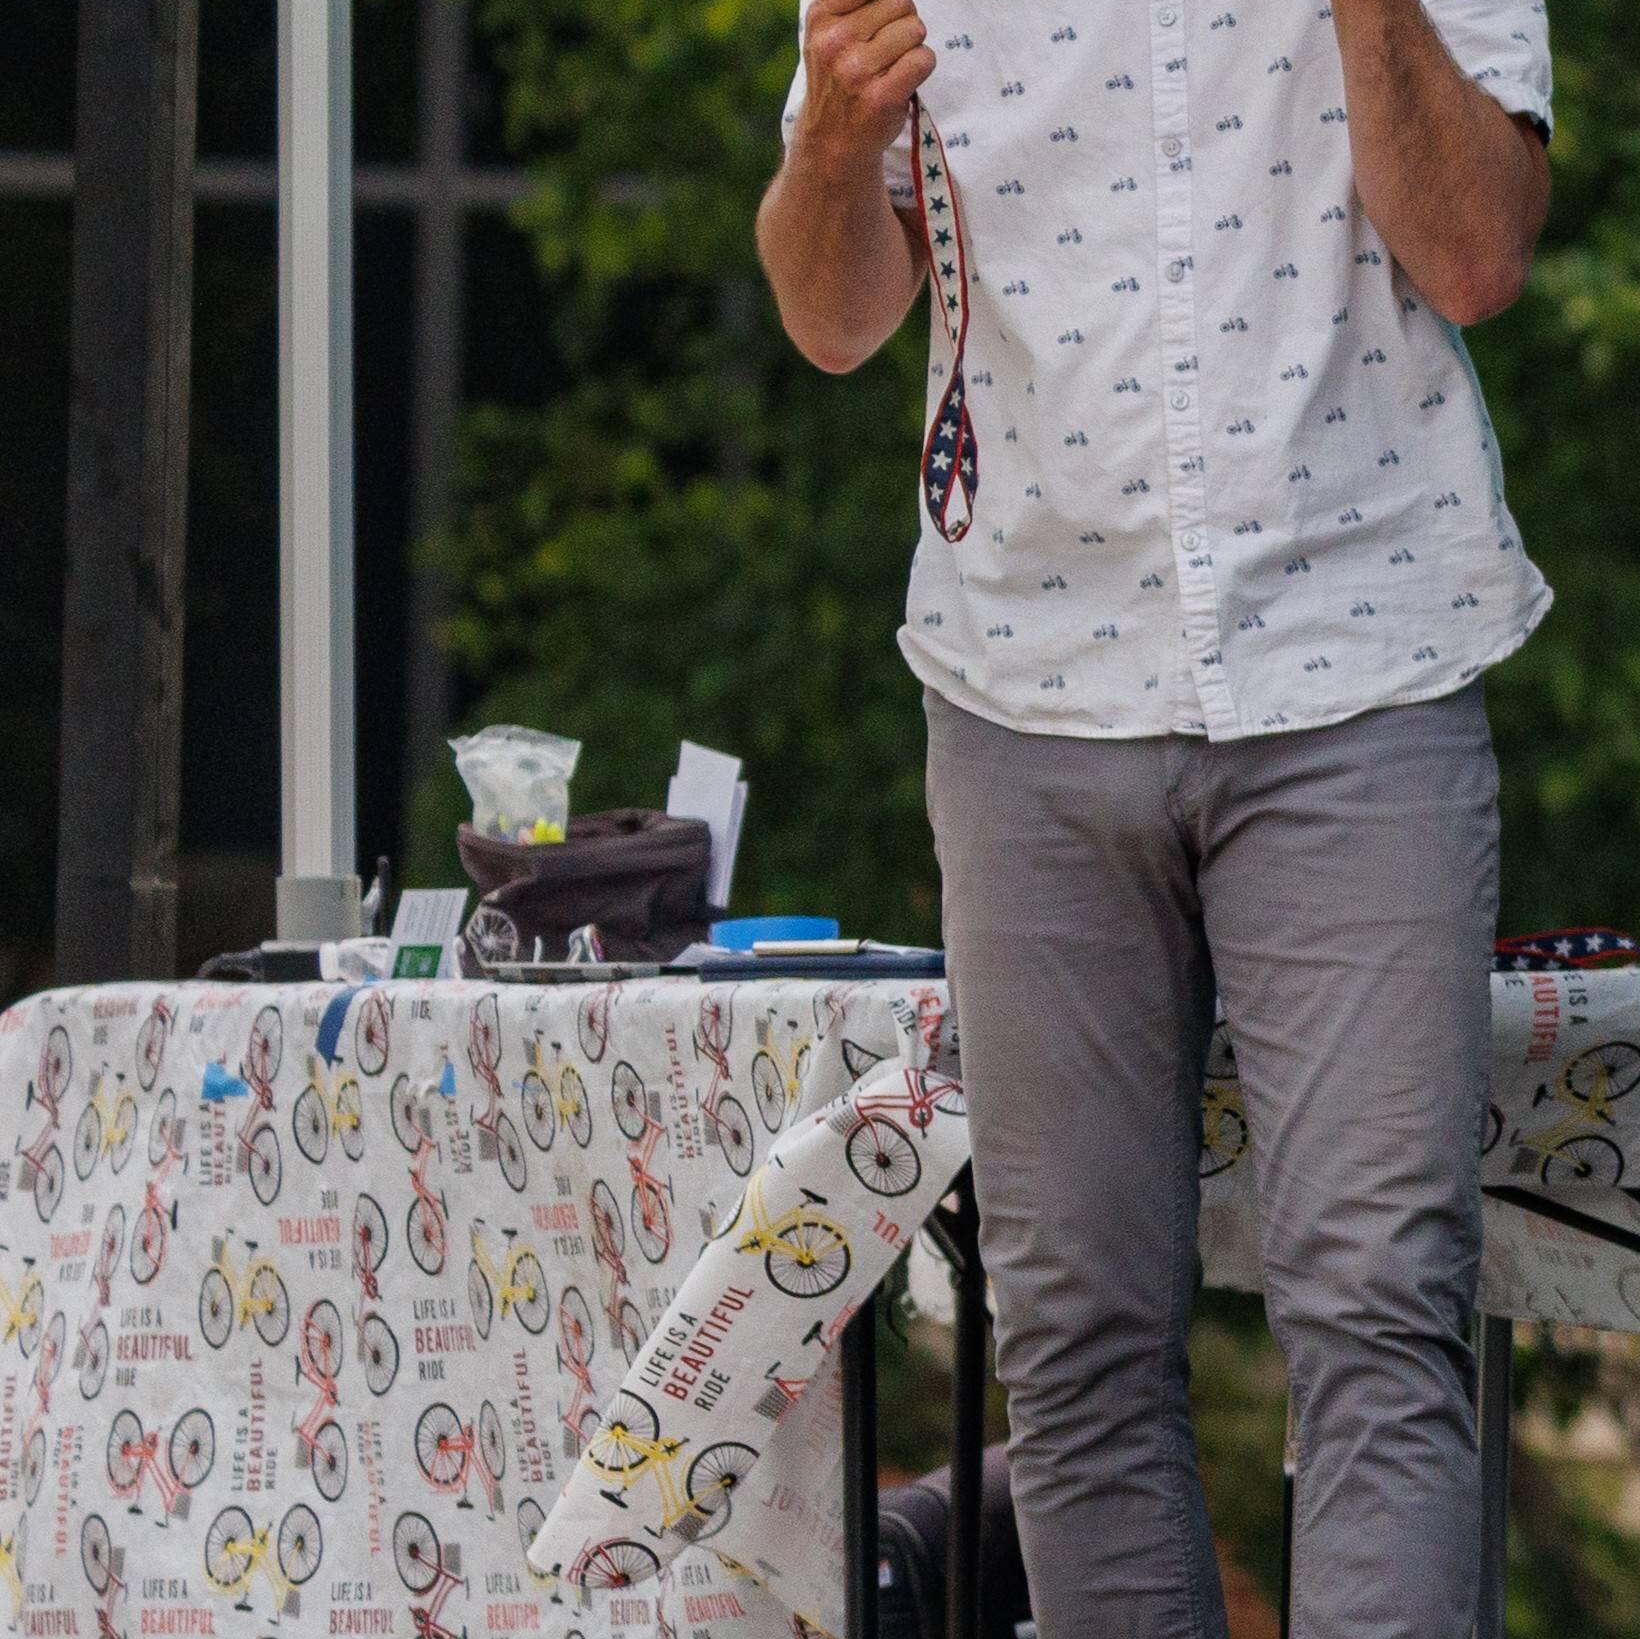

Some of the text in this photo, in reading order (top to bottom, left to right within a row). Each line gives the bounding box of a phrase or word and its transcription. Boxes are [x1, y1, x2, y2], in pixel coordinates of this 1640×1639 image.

[665, 1022, 694, 1159] BEAUTIFUL
[412, 1299, 438, 1320] LIFE
[117, 1334, 193, 1361] BEAUTIFUL
[414, 1326, 477, 1353] BEAUTIFUL
[639, 1346, 676, 1388] LIFE
[664, 1326, 687, 1347] IS
[679, 1311, 699, 1328] A
[662, 1285, 756, 1402] BEAUTIFUL
[418, 1360, 445, 1381] RIDE
[693, 1368, 732, 1412] RIDE
[246, 1357, 266, 1492] BEAUTIFUL
[512, 1347, 544, 1484] BEAUTIFUL
[231, 1407, 249, 1492] LIFE IS A
[265, 1447, 278, 1491] RIDE
[142, 1578, 164, 1599] LIFE
[168, 1579, 179, 1599] IS
[139, 1607, 216, 1635] BEAUTIFUL
[329, 1607, 395, 1635] BEAUTIFUL
